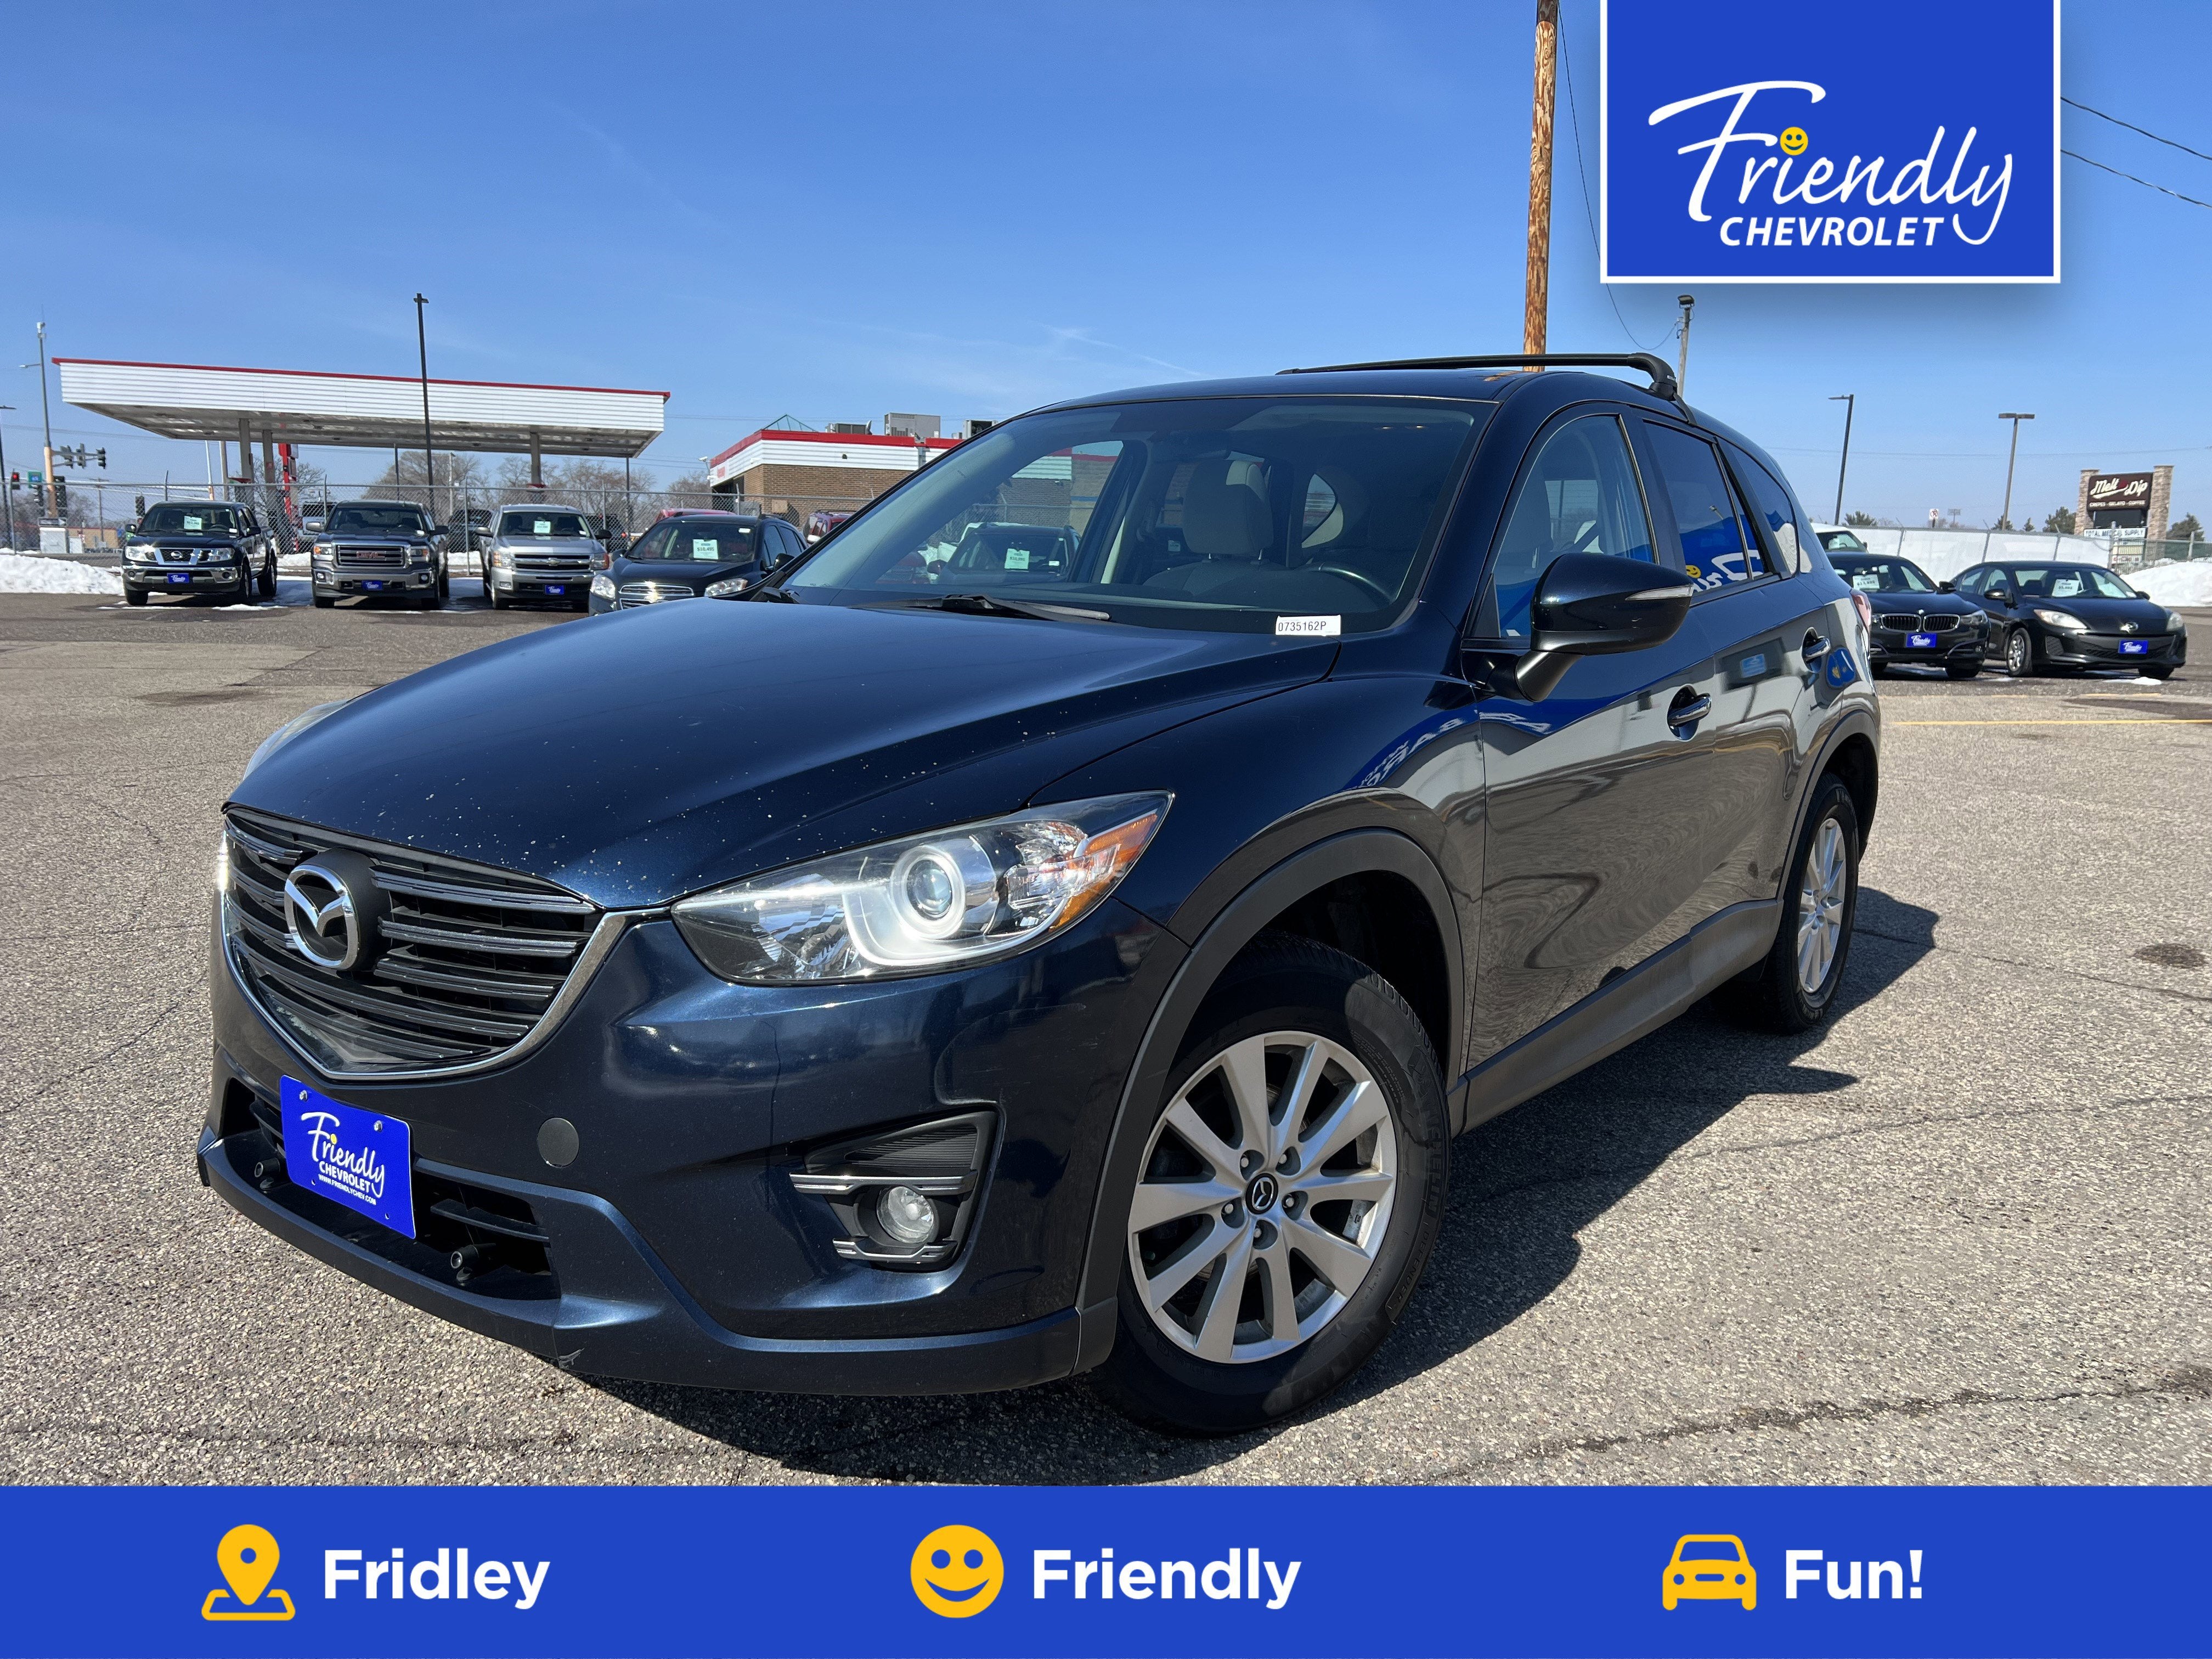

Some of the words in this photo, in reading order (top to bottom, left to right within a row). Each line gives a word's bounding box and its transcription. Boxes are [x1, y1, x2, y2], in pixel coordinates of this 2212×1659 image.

[2124, 479, 2148, 497] Dip
[1278, 621, 1327, 631] 0735162P
[301, 1111, 385, 1198] Friendly
[319, 1161, 371, 1193] CHEVROLET
[1397, 1232, 1430, 1305] DEFENDER
